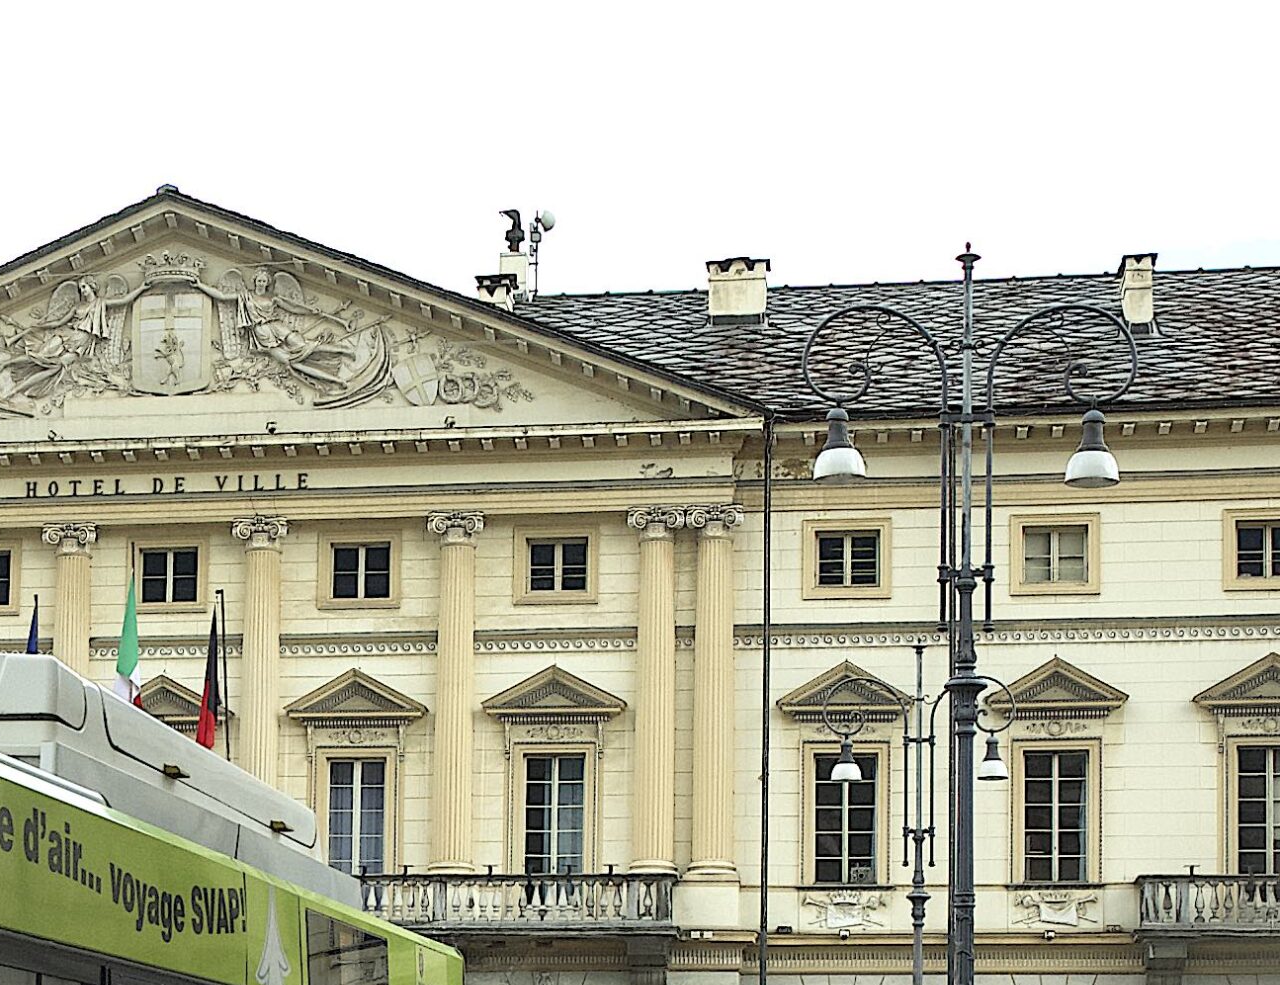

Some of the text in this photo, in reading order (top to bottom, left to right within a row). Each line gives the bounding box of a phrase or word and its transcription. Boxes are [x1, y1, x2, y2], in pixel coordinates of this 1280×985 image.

[25, 472, 310, 499] HOTEL DE VILLE
[110, 862, 186, 942] voyage
[190, 884, 248, 935] SVAP!
